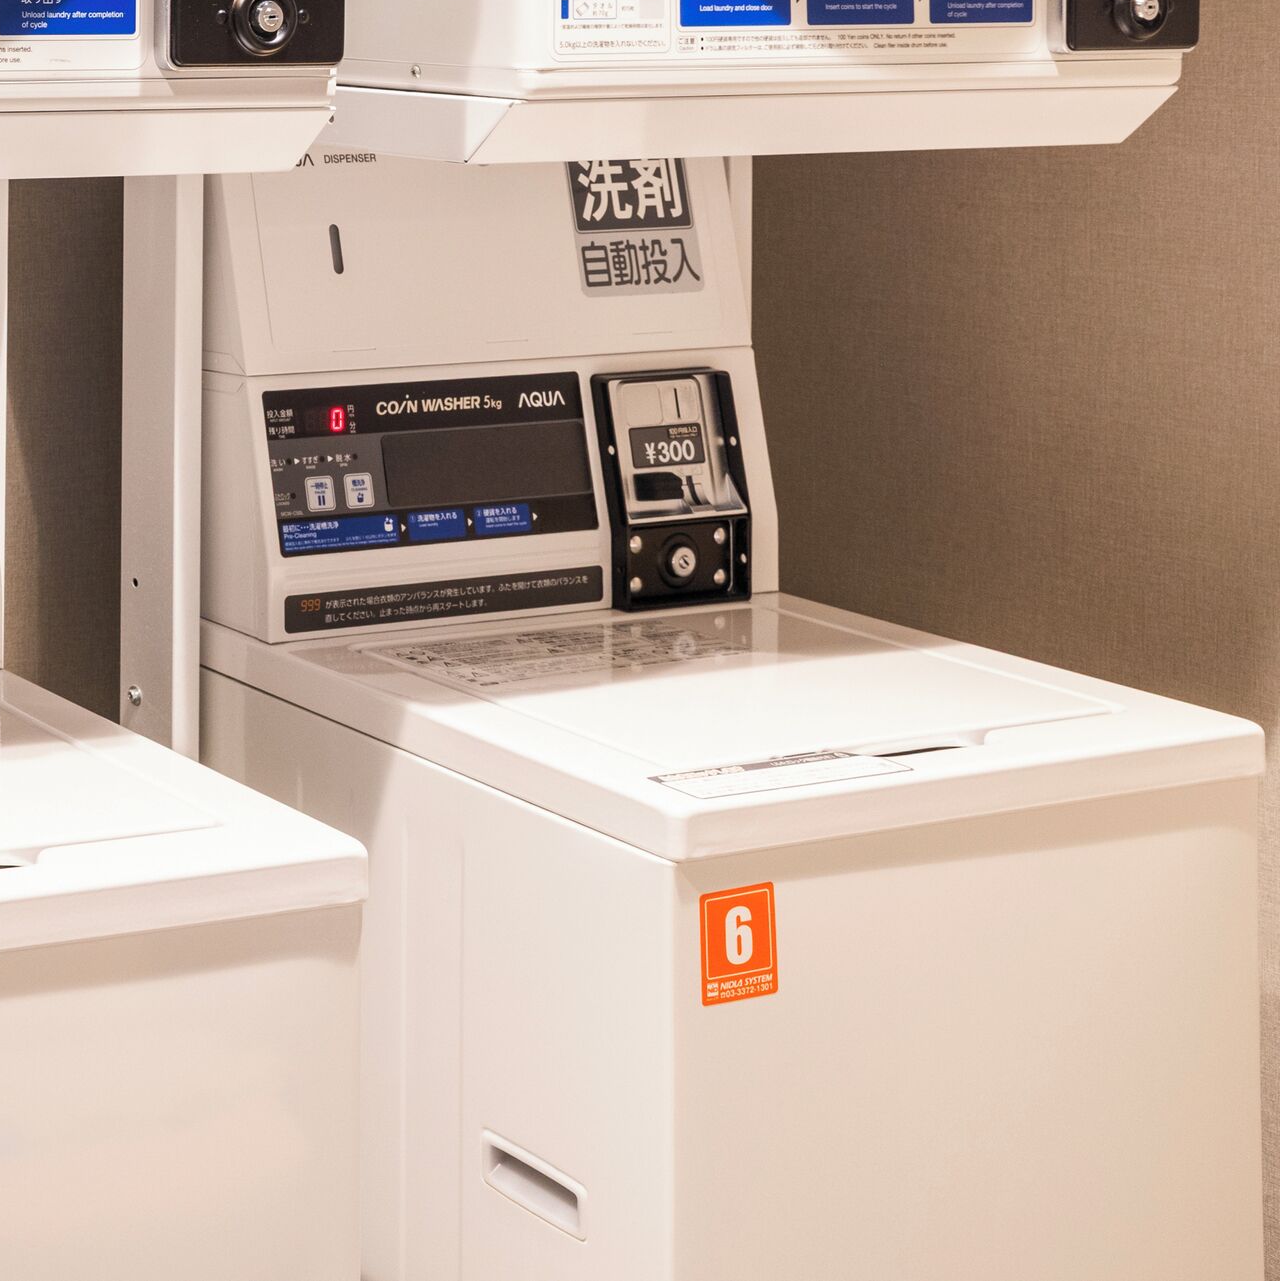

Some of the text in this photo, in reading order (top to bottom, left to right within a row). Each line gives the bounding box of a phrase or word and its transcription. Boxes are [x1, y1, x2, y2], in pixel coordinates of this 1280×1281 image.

[323, 153, 377, 164] DISPENSER
[577, 158, 683, 222] 洗剤
[581, 238, 701, 288] 自動投入
[422, 396, 480, 412] WASHER
[518, 390, 566, 408] AQUA
[332, 409, 343, 430] 0
[645, 439, 695, 464] ¥300
[300, 598, 321, 613] 999
[725, 905, 753, 965] 6
[745, 973, 773, 986] SYSTEM
